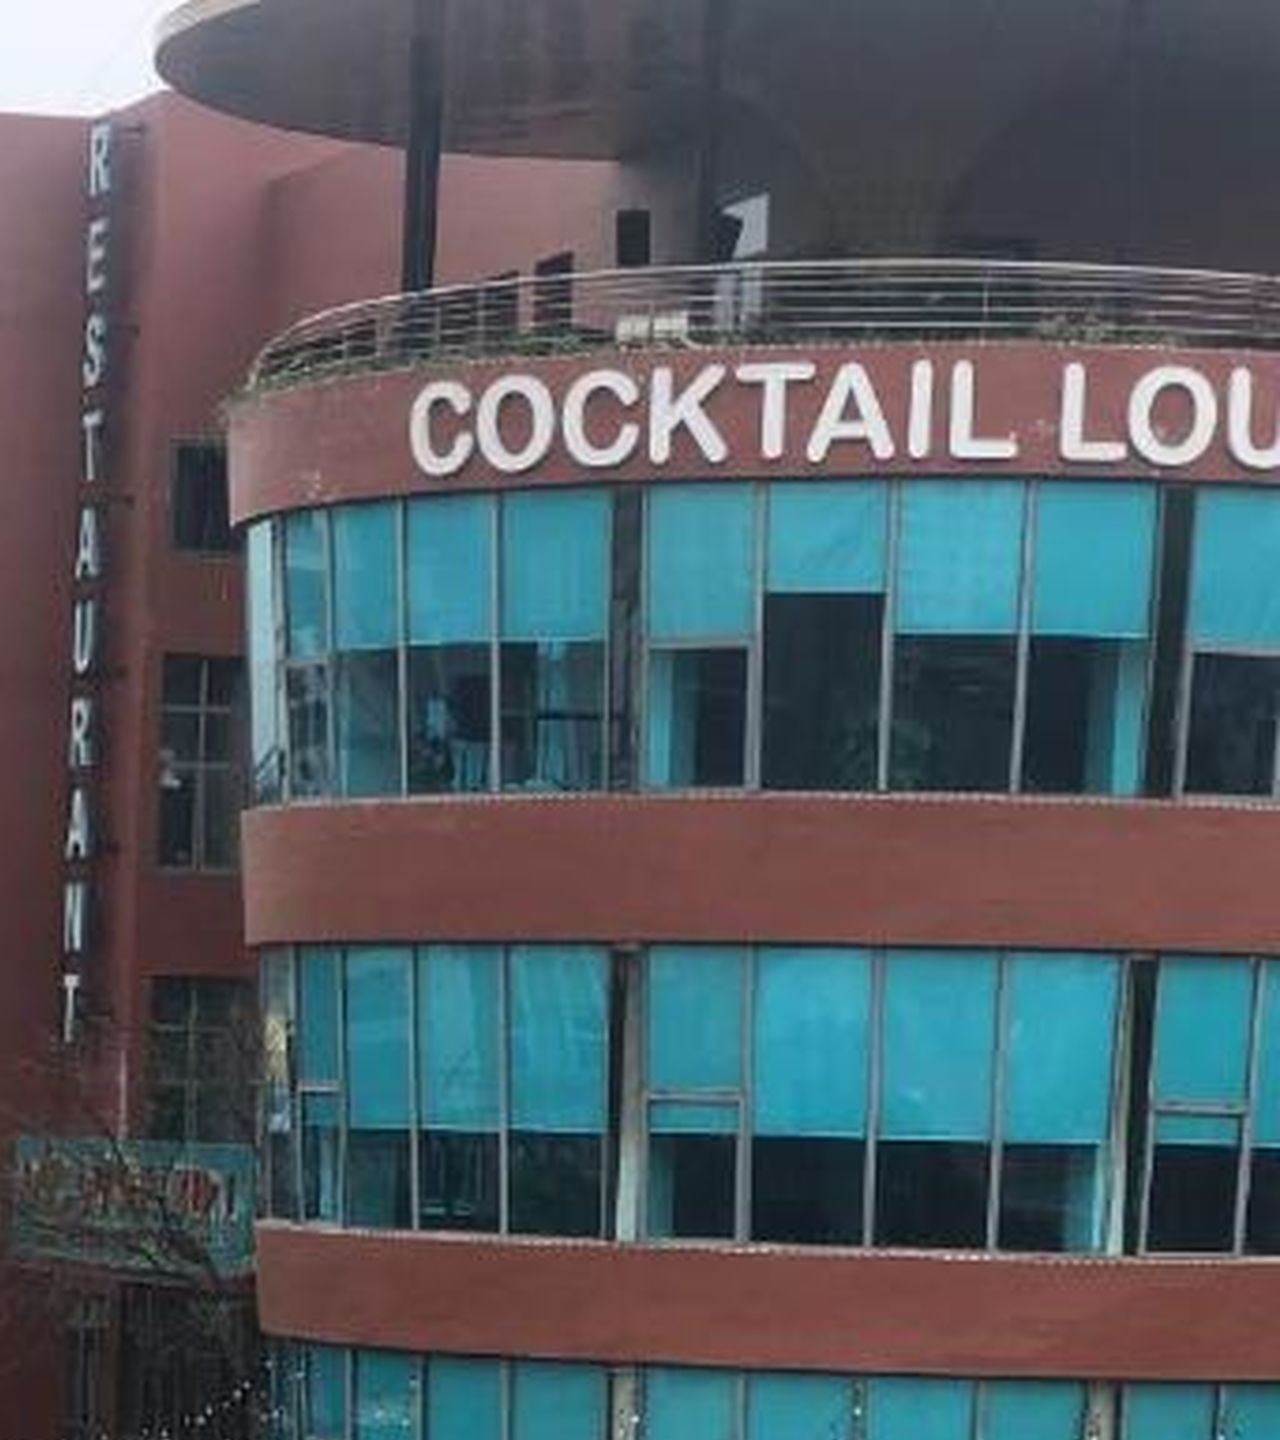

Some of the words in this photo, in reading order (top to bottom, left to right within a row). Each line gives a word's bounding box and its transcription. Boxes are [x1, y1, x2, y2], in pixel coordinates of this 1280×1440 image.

[62, 122, 113, 1045] RESTAURANT
[409, 358, 1019, 478] COCKTAIL
[1058, 361, 1280, 469] LOU
